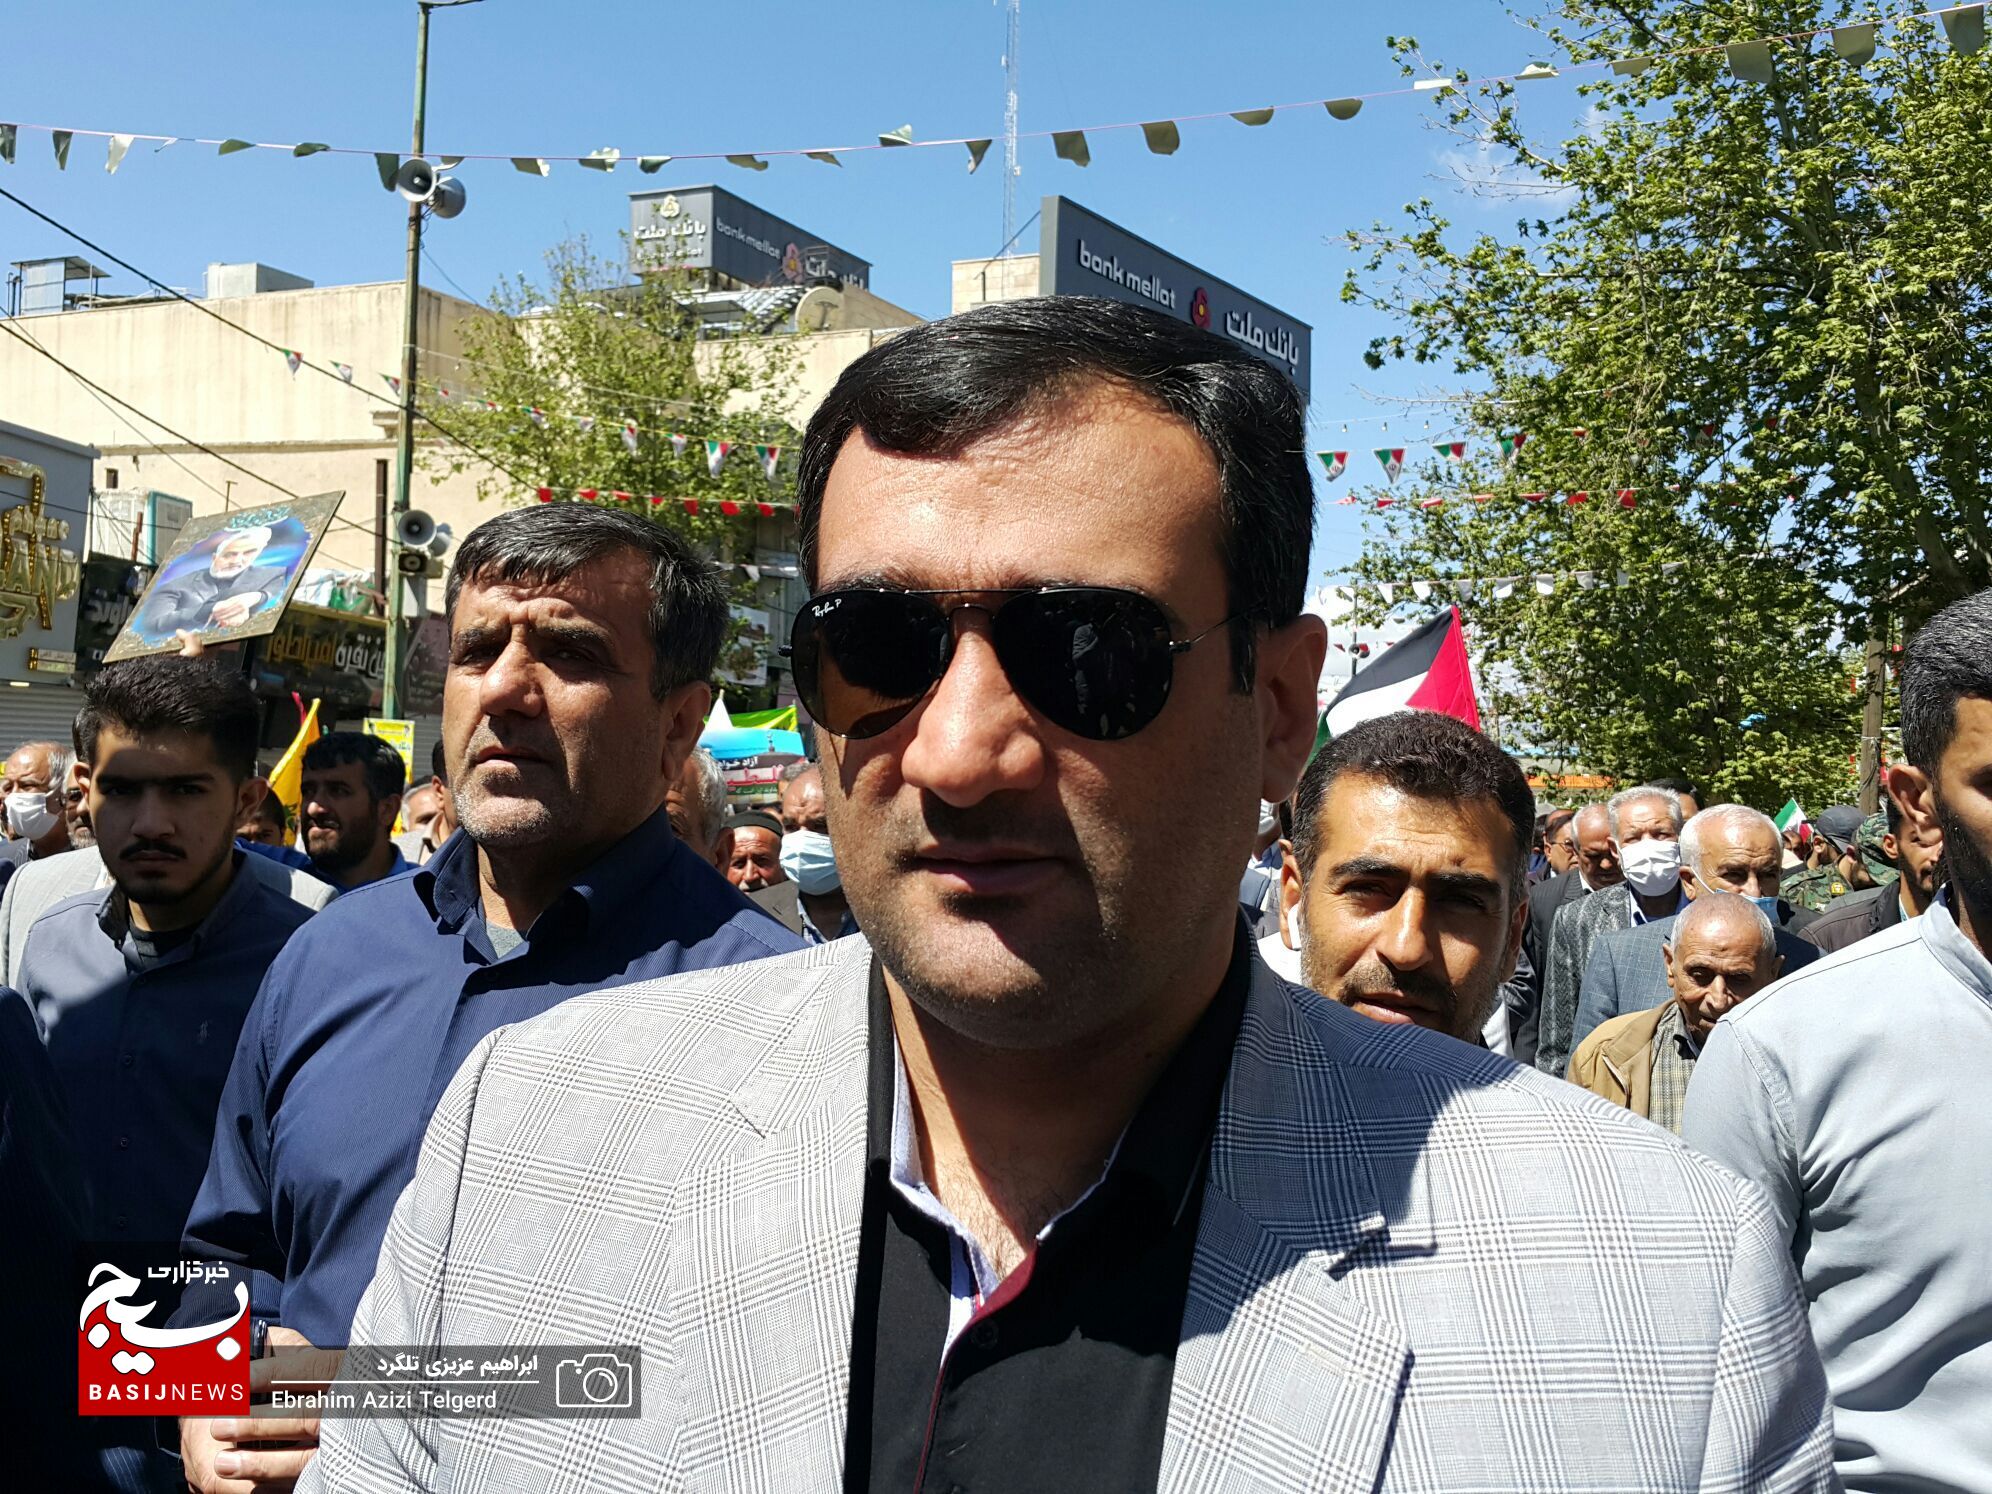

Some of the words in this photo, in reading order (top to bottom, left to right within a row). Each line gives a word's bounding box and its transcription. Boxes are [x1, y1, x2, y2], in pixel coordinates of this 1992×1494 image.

[715, 216, 745, 242] bank
[745, 237, 781, 260] mellat
[1079, 240, 1125, 283] bank
[1126, 274, 1176, 309] mellat
[1226, 309, 1265, 348] ملت
[1264, 326, 1299, 376] بانک
[335, 632, 371, 673] نقره
[742, 755, 758, 768] آزاد
